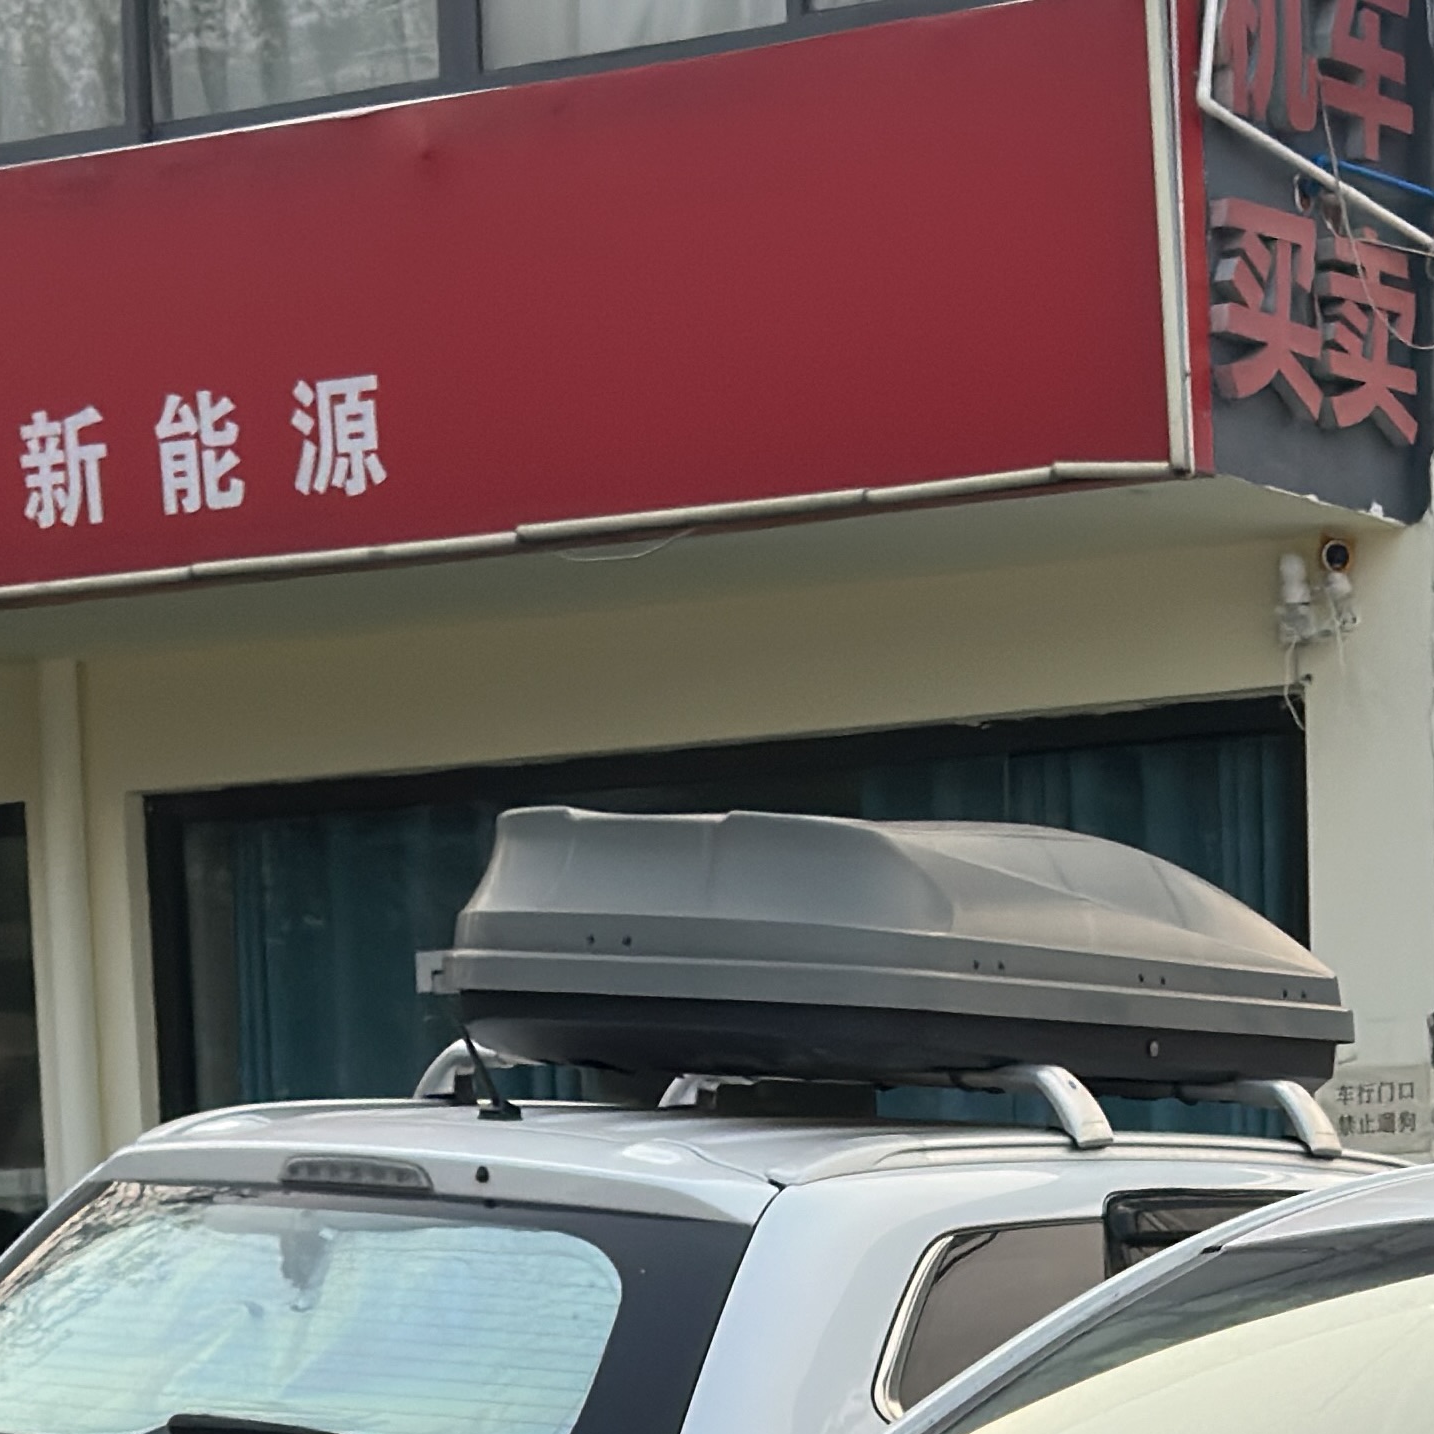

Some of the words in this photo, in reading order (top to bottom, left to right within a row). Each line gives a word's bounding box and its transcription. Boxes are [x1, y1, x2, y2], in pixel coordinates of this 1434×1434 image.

[1210, 198, 1418, 445] 买卖
[18, 374, 386, 530] 新能源
[1336, 1082, 1414, 1105] 车行门口
